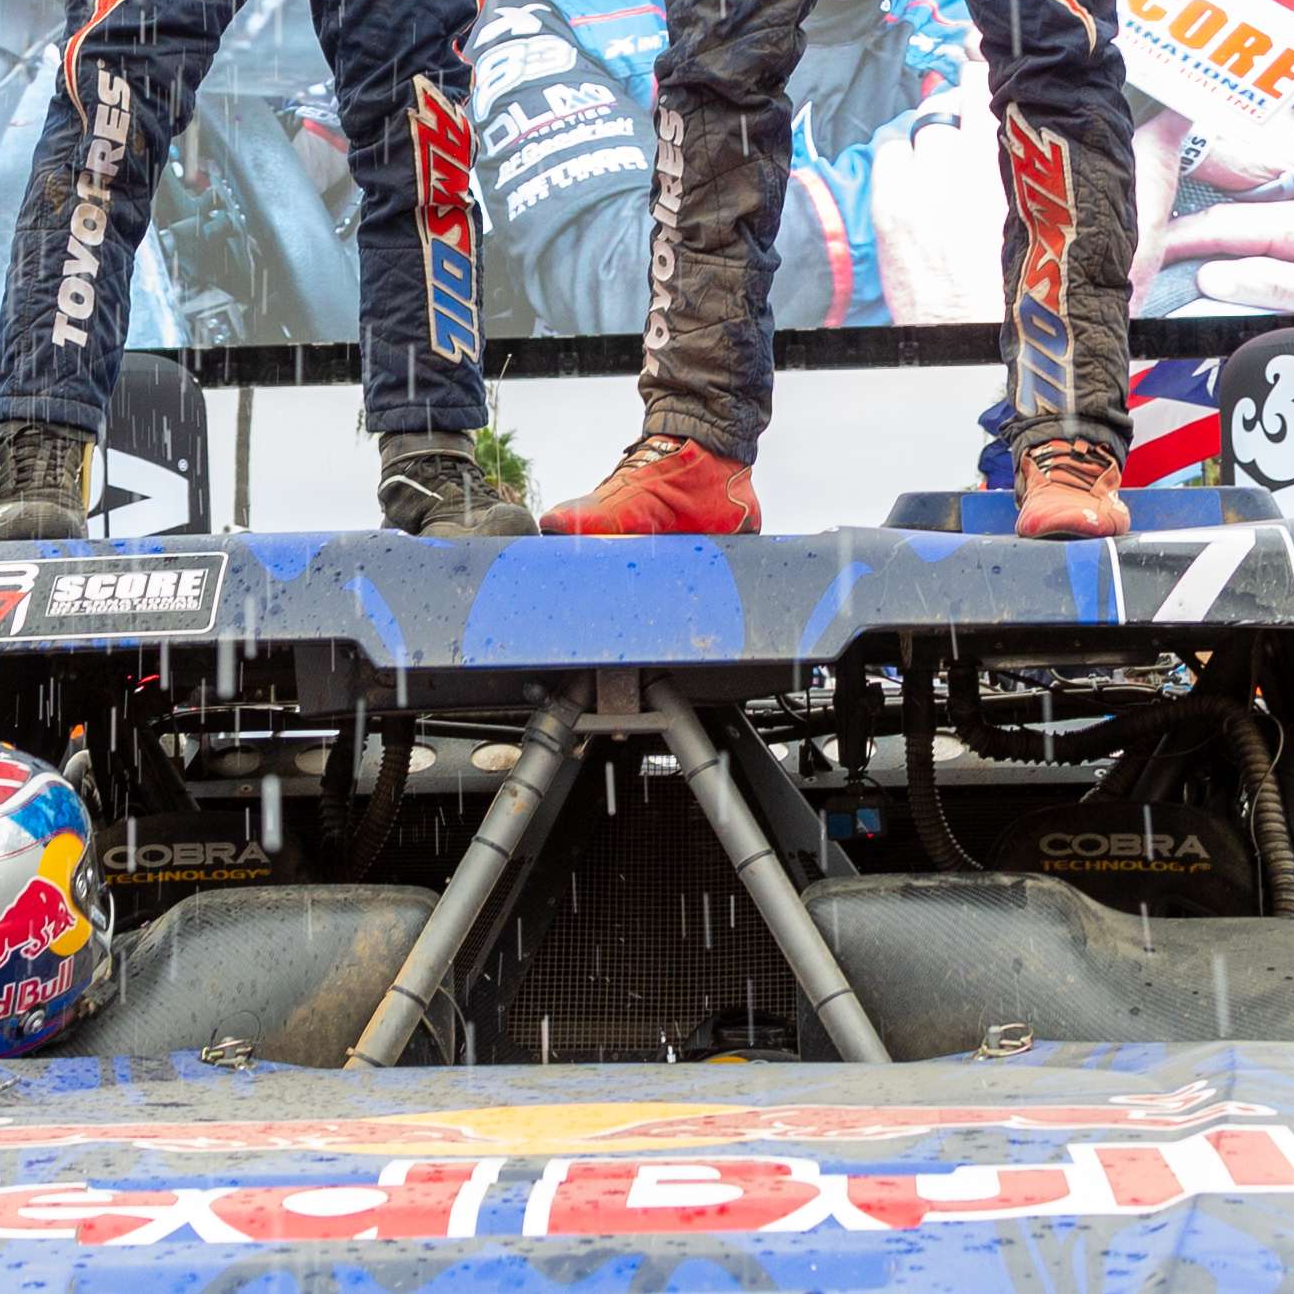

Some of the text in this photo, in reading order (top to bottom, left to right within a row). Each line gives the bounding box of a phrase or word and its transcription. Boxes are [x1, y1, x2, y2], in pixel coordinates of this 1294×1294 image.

[407, 73, 480, 364] AMSOIL
[52, 202, 107, 349] TOYO
[1000, 102, 1078, 417] AMSOIL
[52, 570, 204, 603] SCORE
[1139, 527, 1257, 623] 7
[103, 841, 271, 871] COBRA
[1039, 832, 1211, 858] COBRA
[15, 956, 75, 1015] Bull
